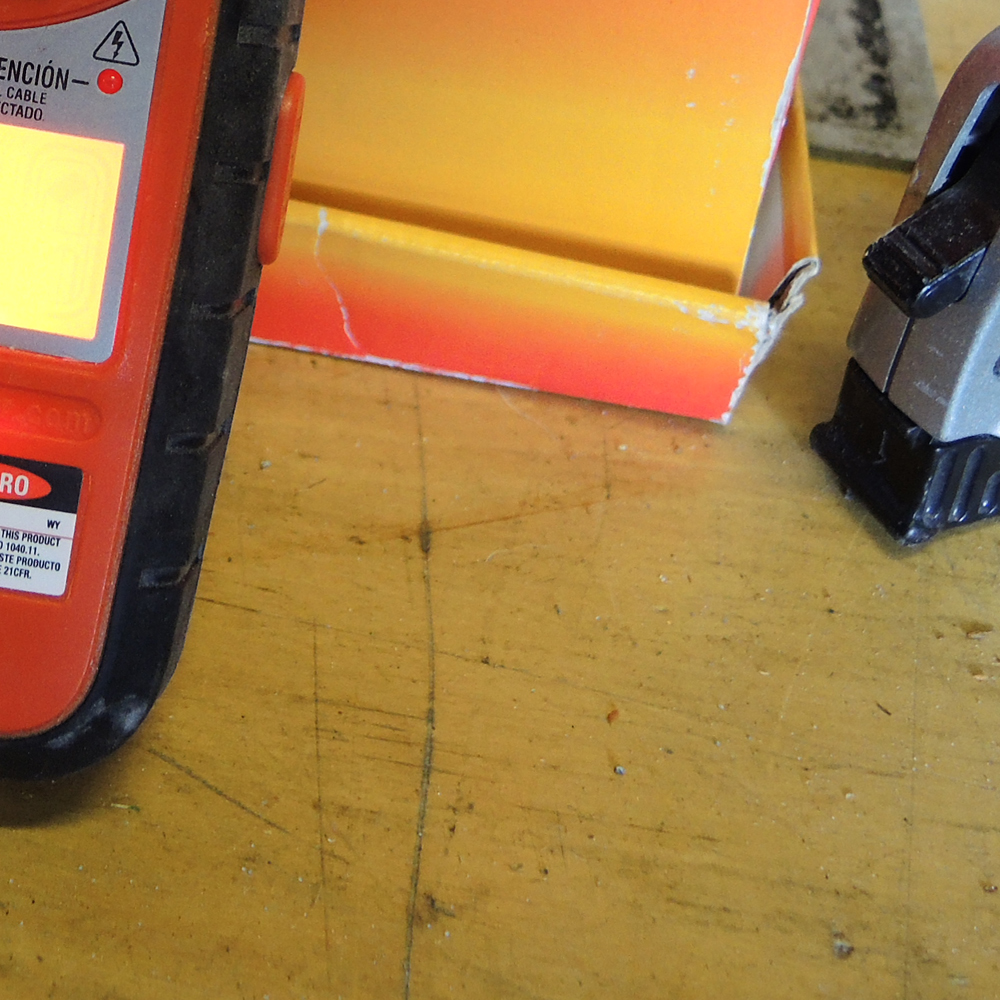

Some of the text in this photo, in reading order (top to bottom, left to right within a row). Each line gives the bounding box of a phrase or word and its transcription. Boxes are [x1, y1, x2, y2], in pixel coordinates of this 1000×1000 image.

[6, 86, 48, 105] CABLE
[47, 519, 61, 530] WY
[1, 528, 20, 541] THIS
[21, 532, 61, 547] PRODUCT
[6, 542, 40, 556] 1040.11.
[16, 556, 61, 572] PRODUCTO
[3, 566, 32, 579] 21CFR.
